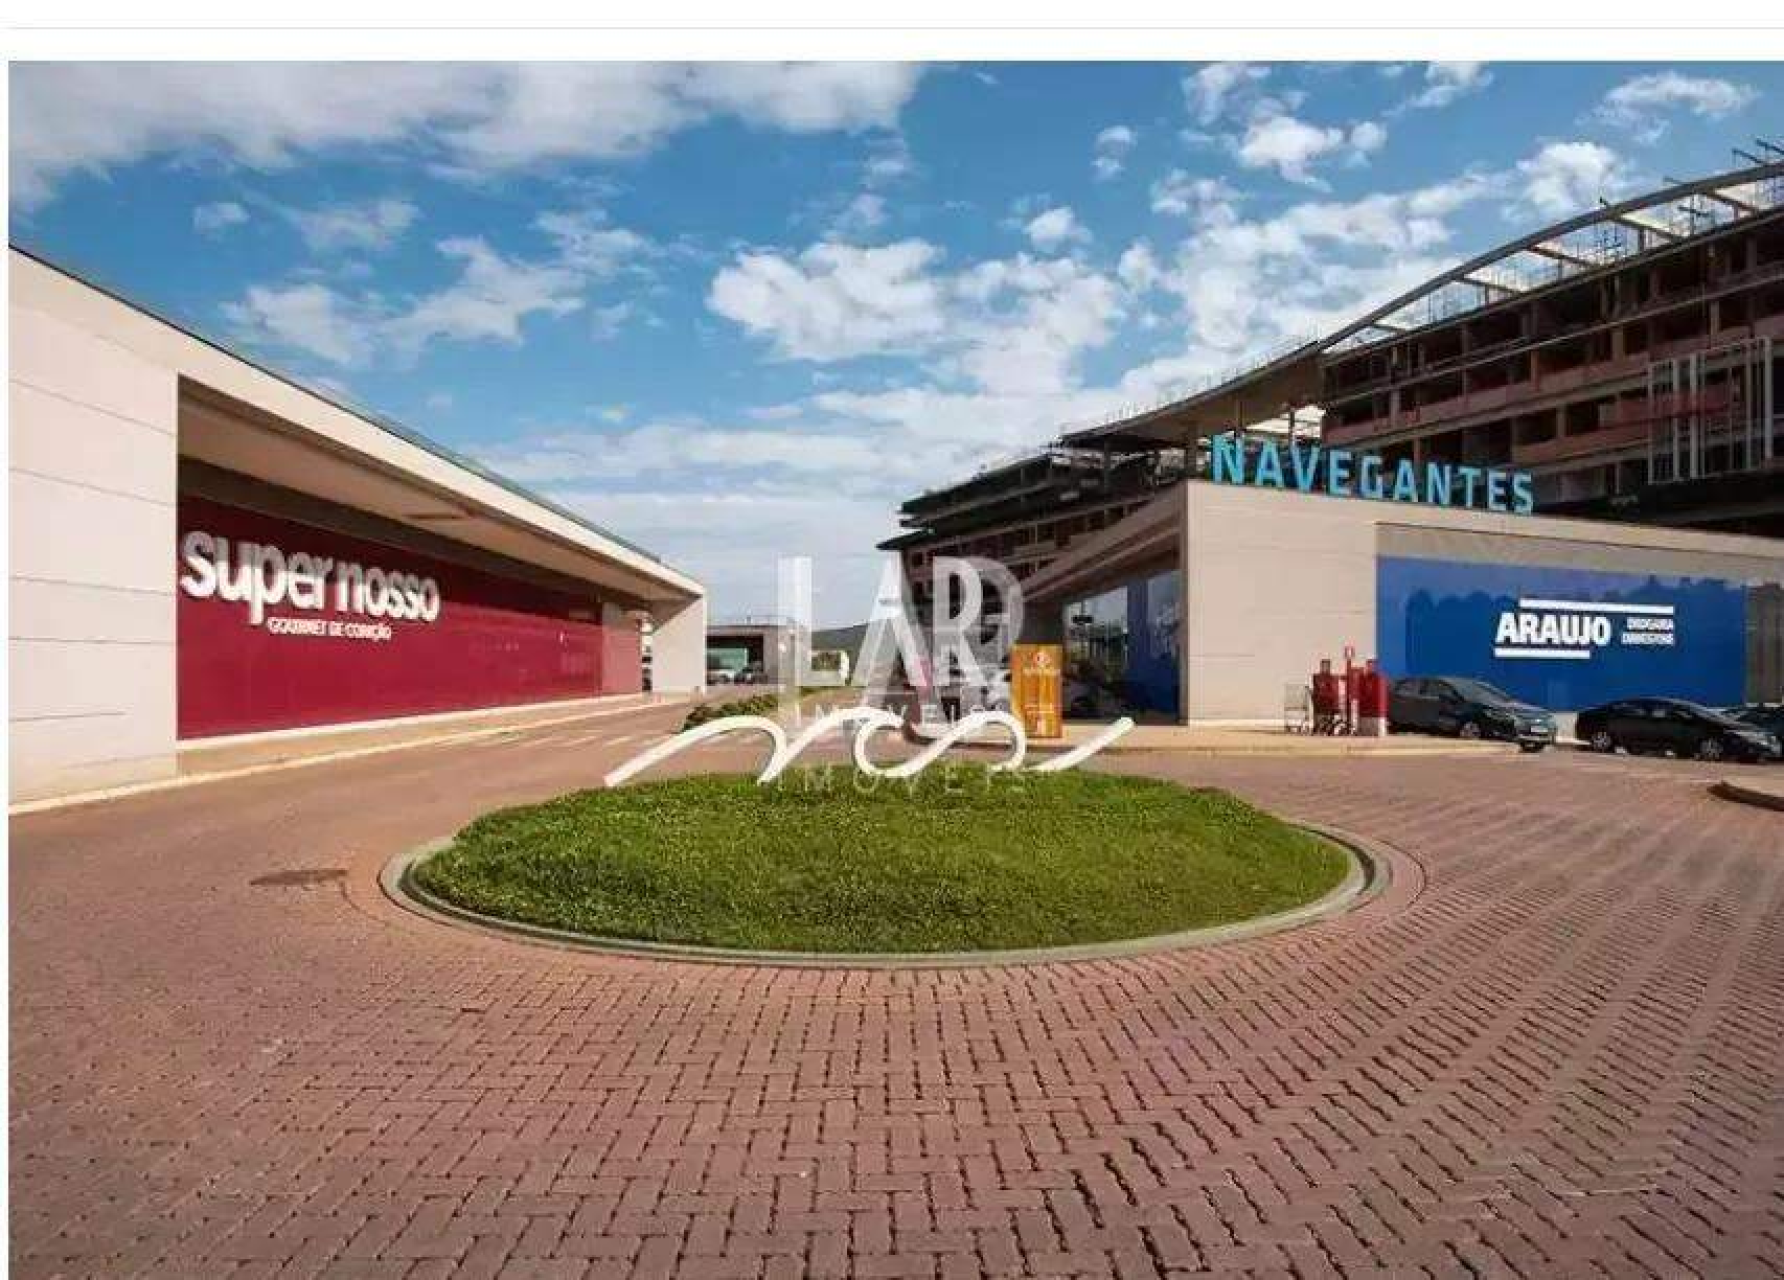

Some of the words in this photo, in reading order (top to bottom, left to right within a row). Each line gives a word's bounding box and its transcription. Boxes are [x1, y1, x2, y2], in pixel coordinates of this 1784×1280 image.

[1211, 433, 1534, 516] NAVEGANTES
[335, 562, 440, 621] nosso
[1495, 612, 1611, 646] ARAUJO
